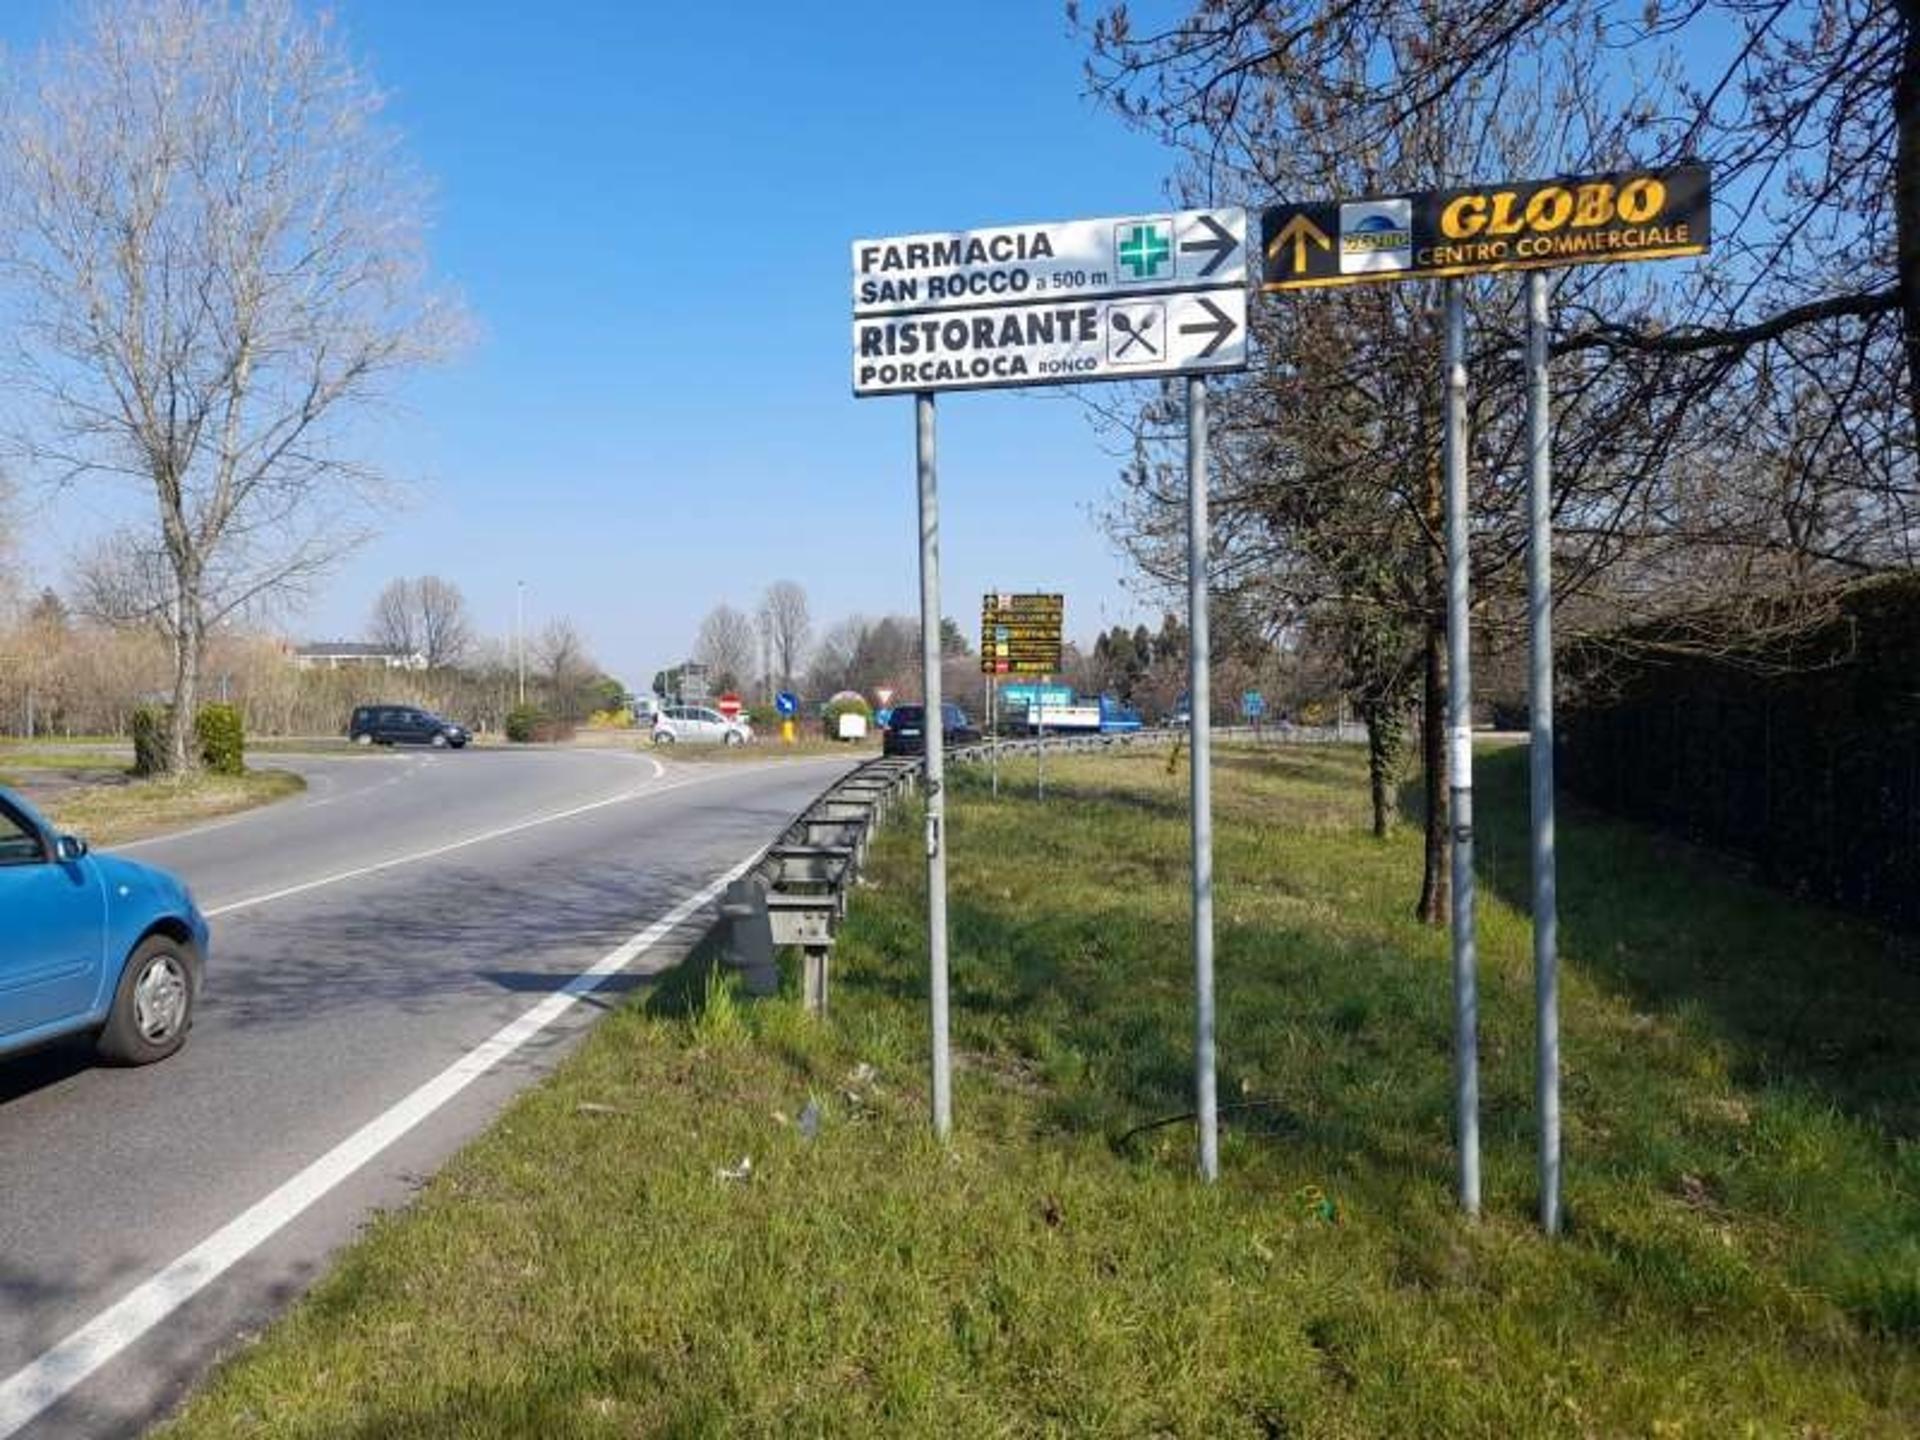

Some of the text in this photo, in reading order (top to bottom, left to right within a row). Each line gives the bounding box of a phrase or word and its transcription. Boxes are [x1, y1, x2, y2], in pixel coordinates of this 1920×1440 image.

[1441, 178, 1666, 239] GLOBO
[861, 232, 1055, 273] FARMACIA
[1417, 241, 1509, 264] CENTRO
[1516, 223, 1689, 256] COMMERCIALE
[861, 268, 1108, 304] SAN ROCCO a 500 m
[861, 307, 1098, 357] RISTORANTE
[861, 355, 1097, 385] PORCALOCA RONCO
